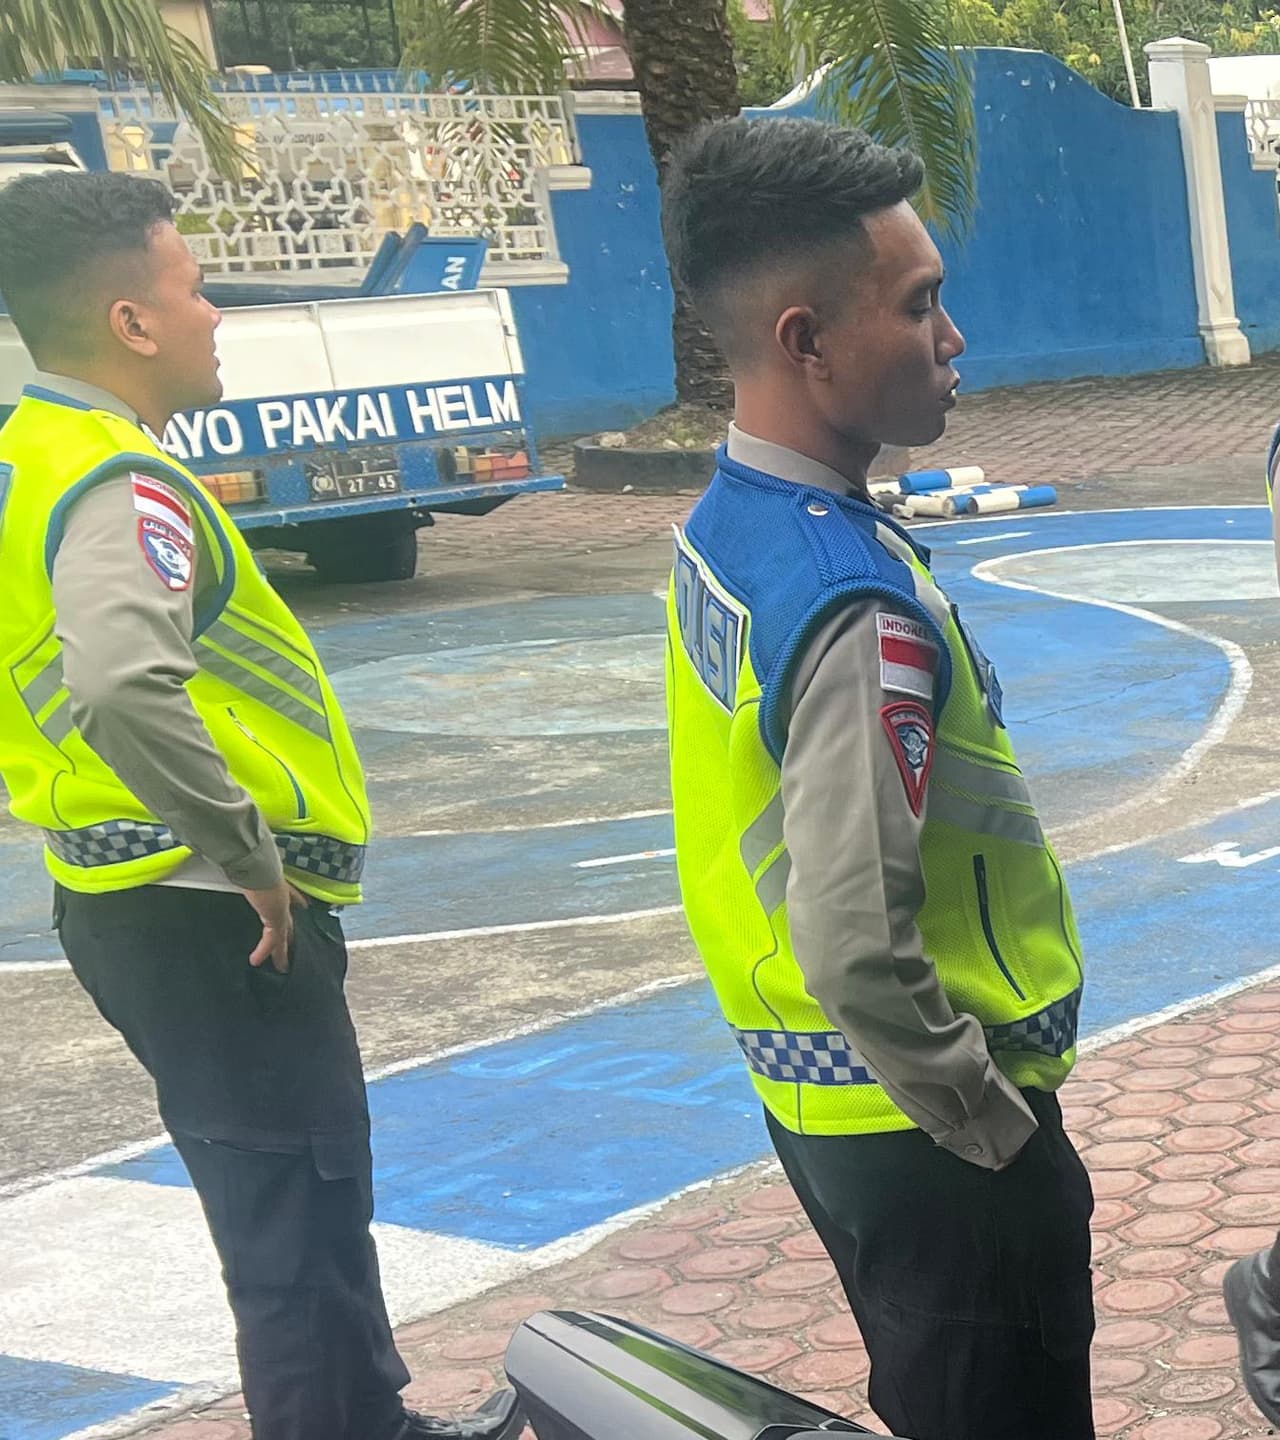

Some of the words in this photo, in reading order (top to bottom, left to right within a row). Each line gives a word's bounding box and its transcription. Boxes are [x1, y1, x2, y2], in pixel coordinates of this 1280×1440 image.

[161, 409, 243, 460] AYO
[257, 391, 398, 449] PAKAI
[405, 380, 522, 434] HELM
[347, 478, 364, 493] 27
[378, 474, 397, 489] 45
[881, 617, 929, 639] INDONE
